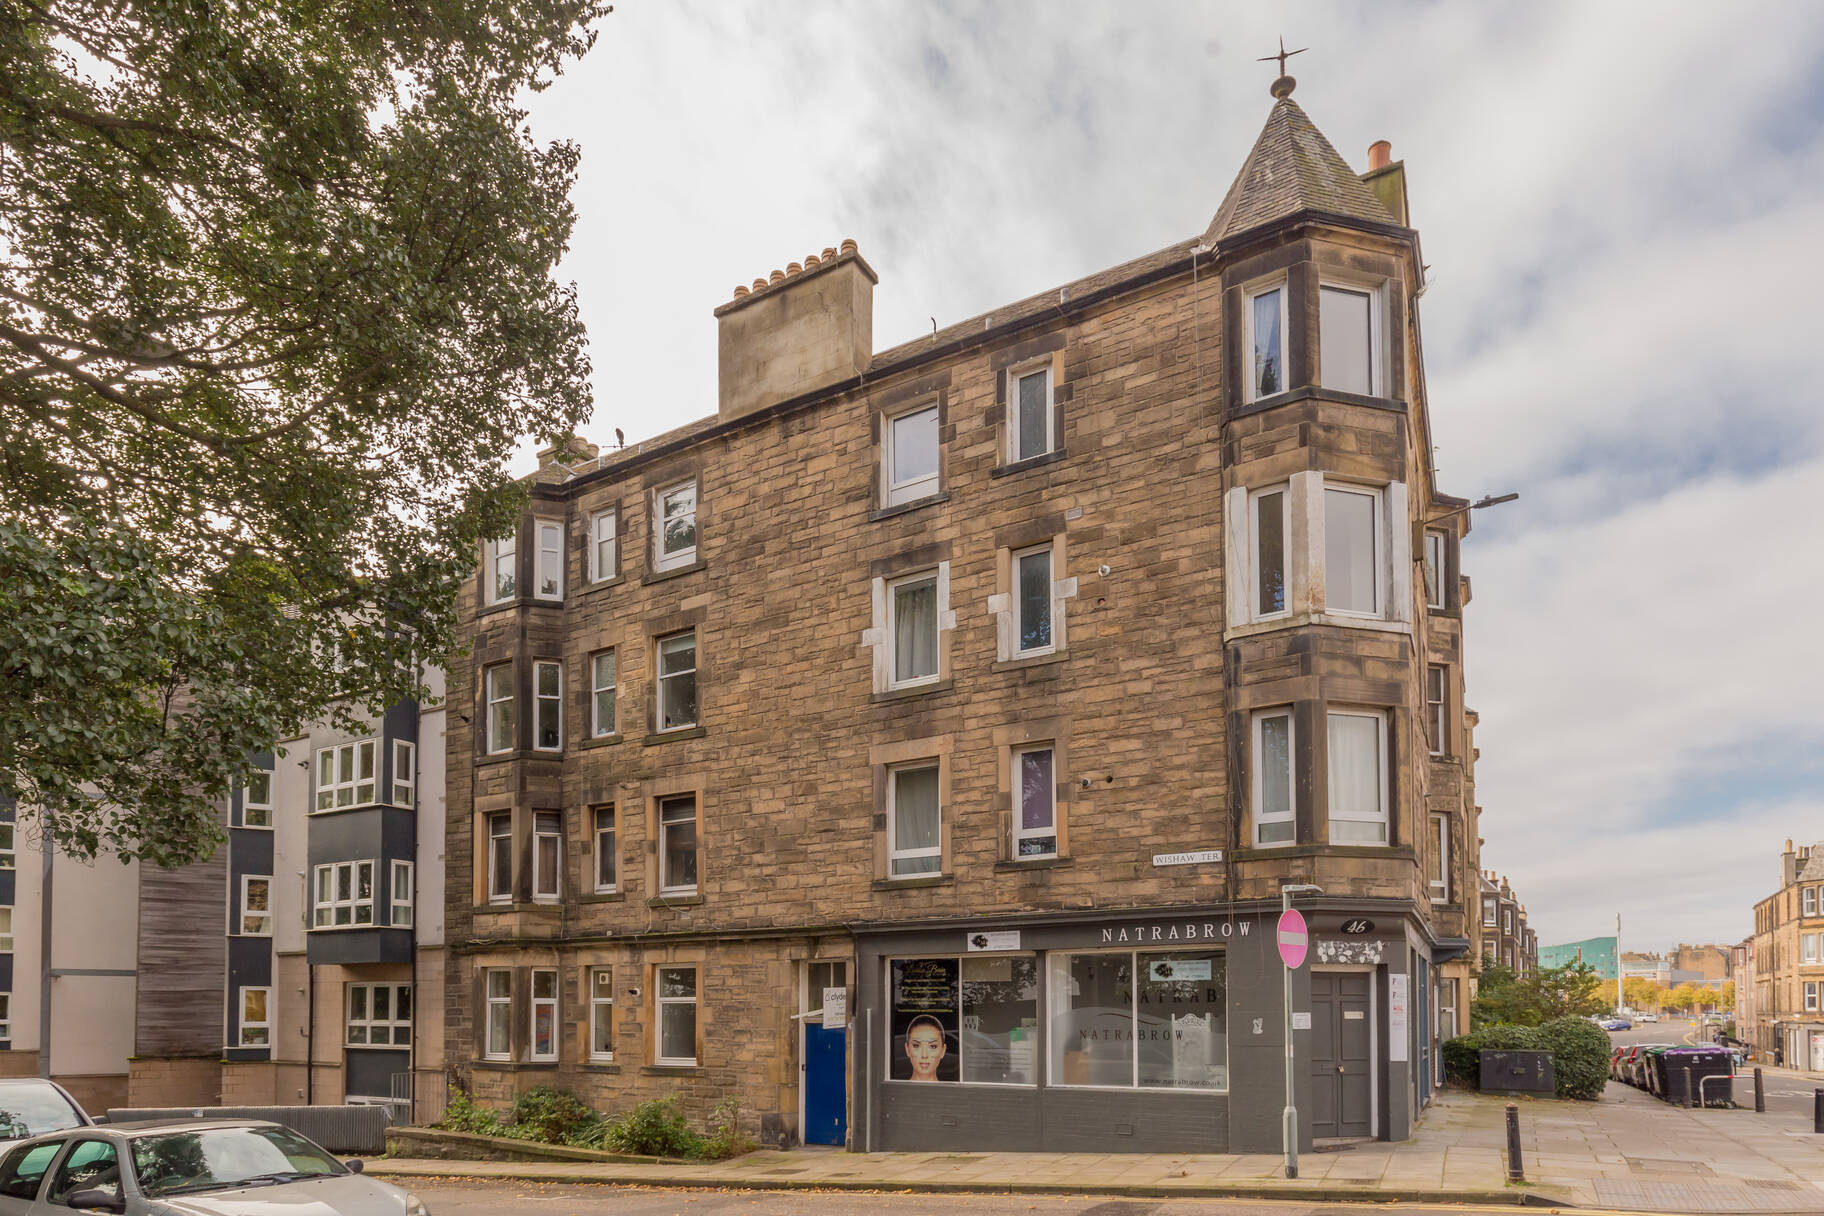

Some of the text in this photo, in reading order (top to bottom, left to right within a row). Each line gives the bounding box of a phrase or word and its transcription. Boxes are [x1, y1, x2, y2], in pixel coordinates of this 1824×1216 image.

[1155, 852, 1219, 864] WISHAW TER
[1102, 921, 1251, 942] NATRABROW
[1347, 920, 1367, 934] 46
[1079, 1029, 1184, 1041] NATRABROW
